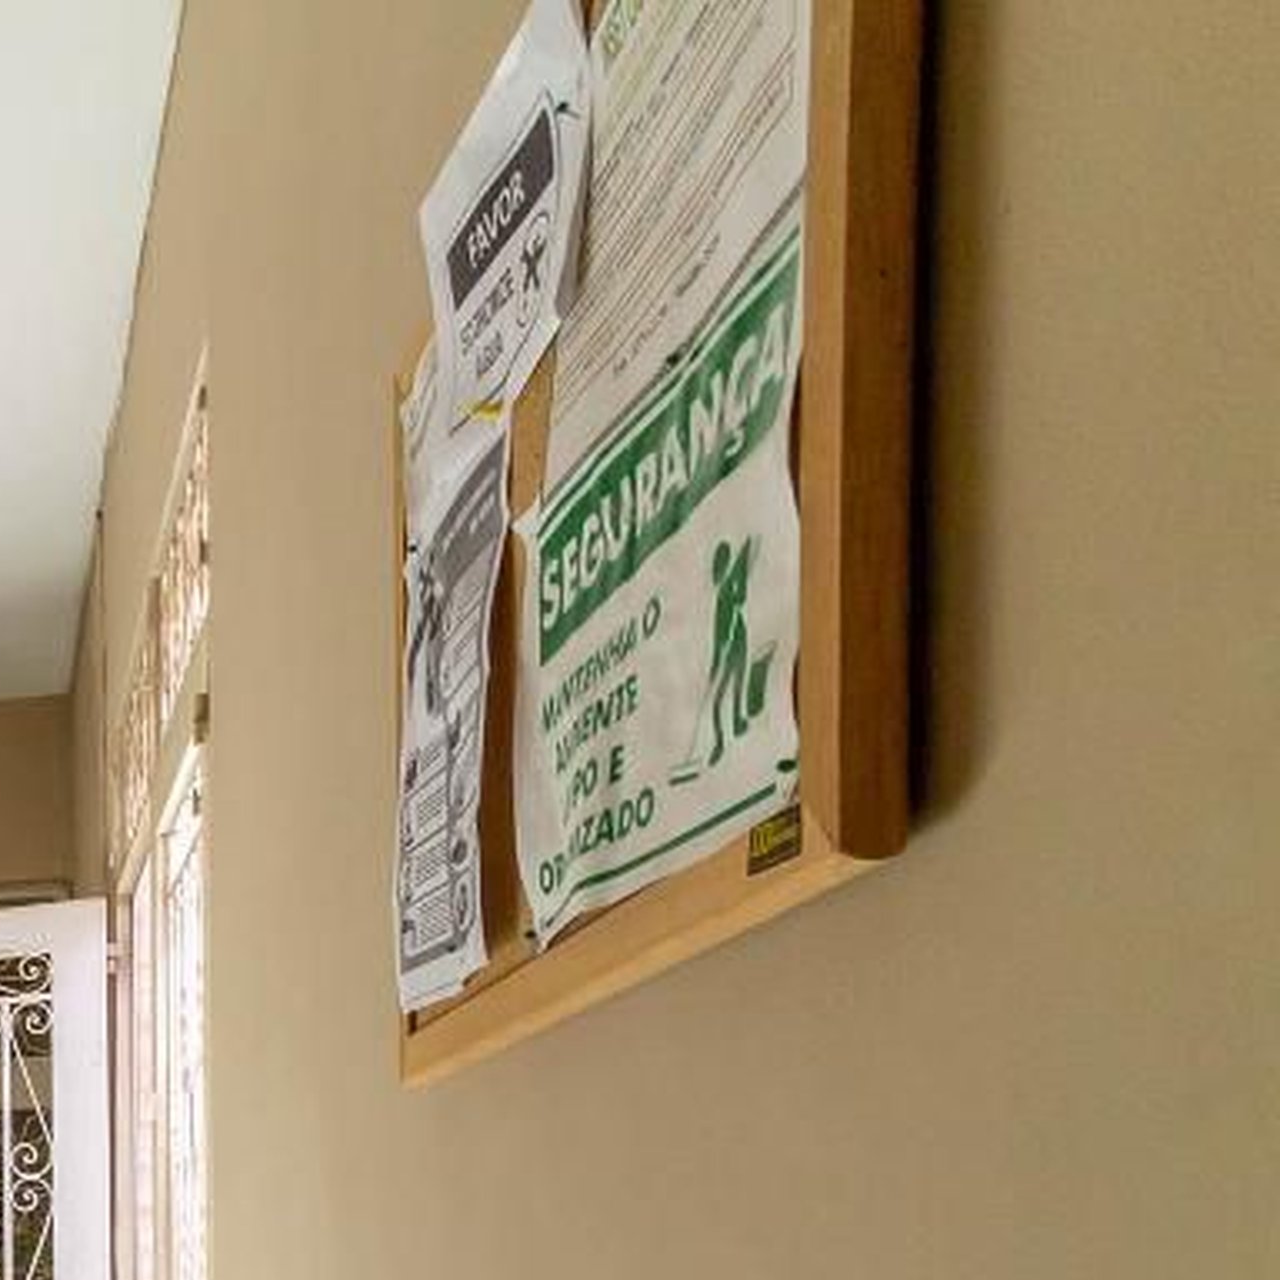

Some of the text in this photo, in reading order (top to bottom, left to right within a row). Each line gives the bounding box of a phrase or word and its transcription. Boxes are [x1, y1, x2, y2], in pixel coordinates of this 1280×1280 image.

[466, 170, 525, 268] FAVOR
[542, 303, 787, 631] SEGURANÇA
[642, 597, 661, 640] O
[609, 745, 625, 785] E
